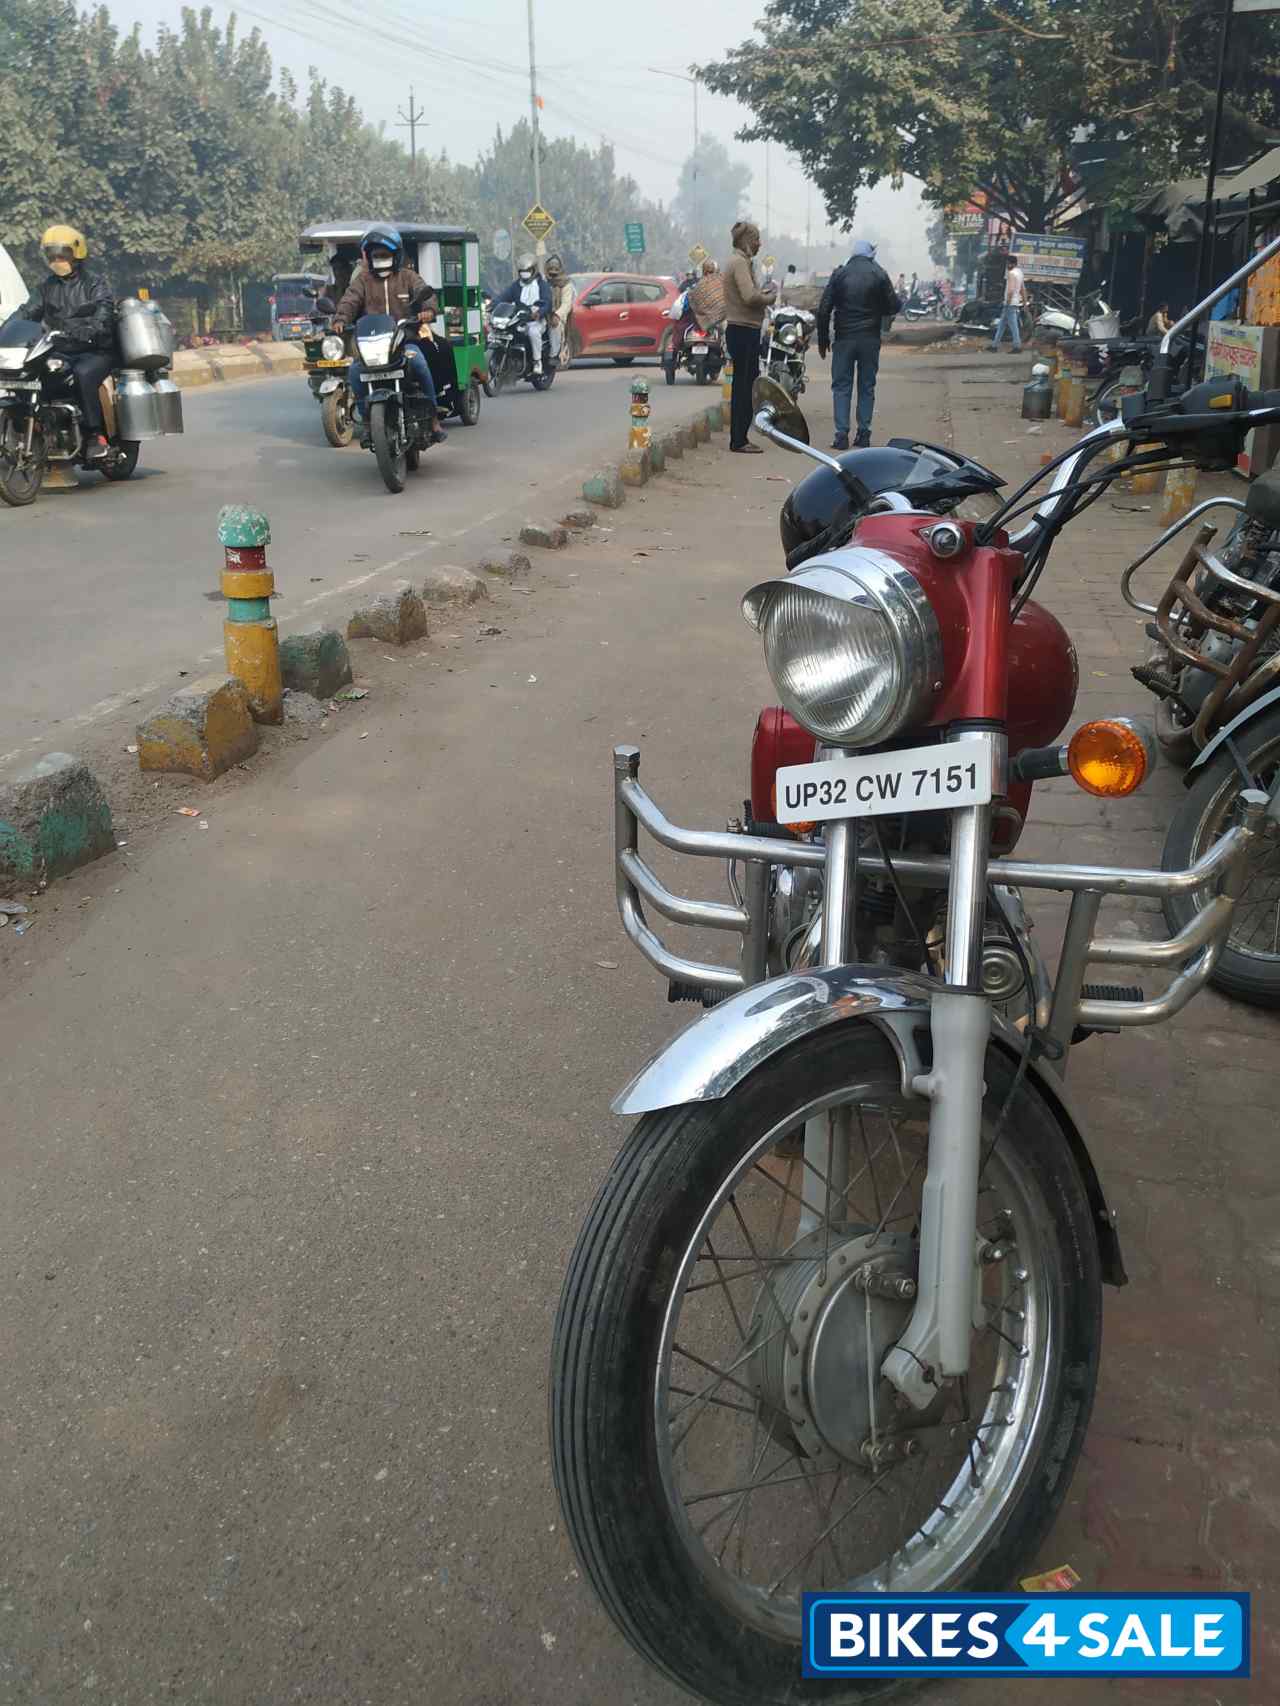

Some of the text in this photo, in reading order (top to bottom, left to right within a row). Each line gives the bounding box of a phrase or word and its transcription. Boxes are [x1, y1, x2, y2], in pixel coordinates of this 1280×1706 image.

[785, 763, 977, 809] UP32 CW 7151
